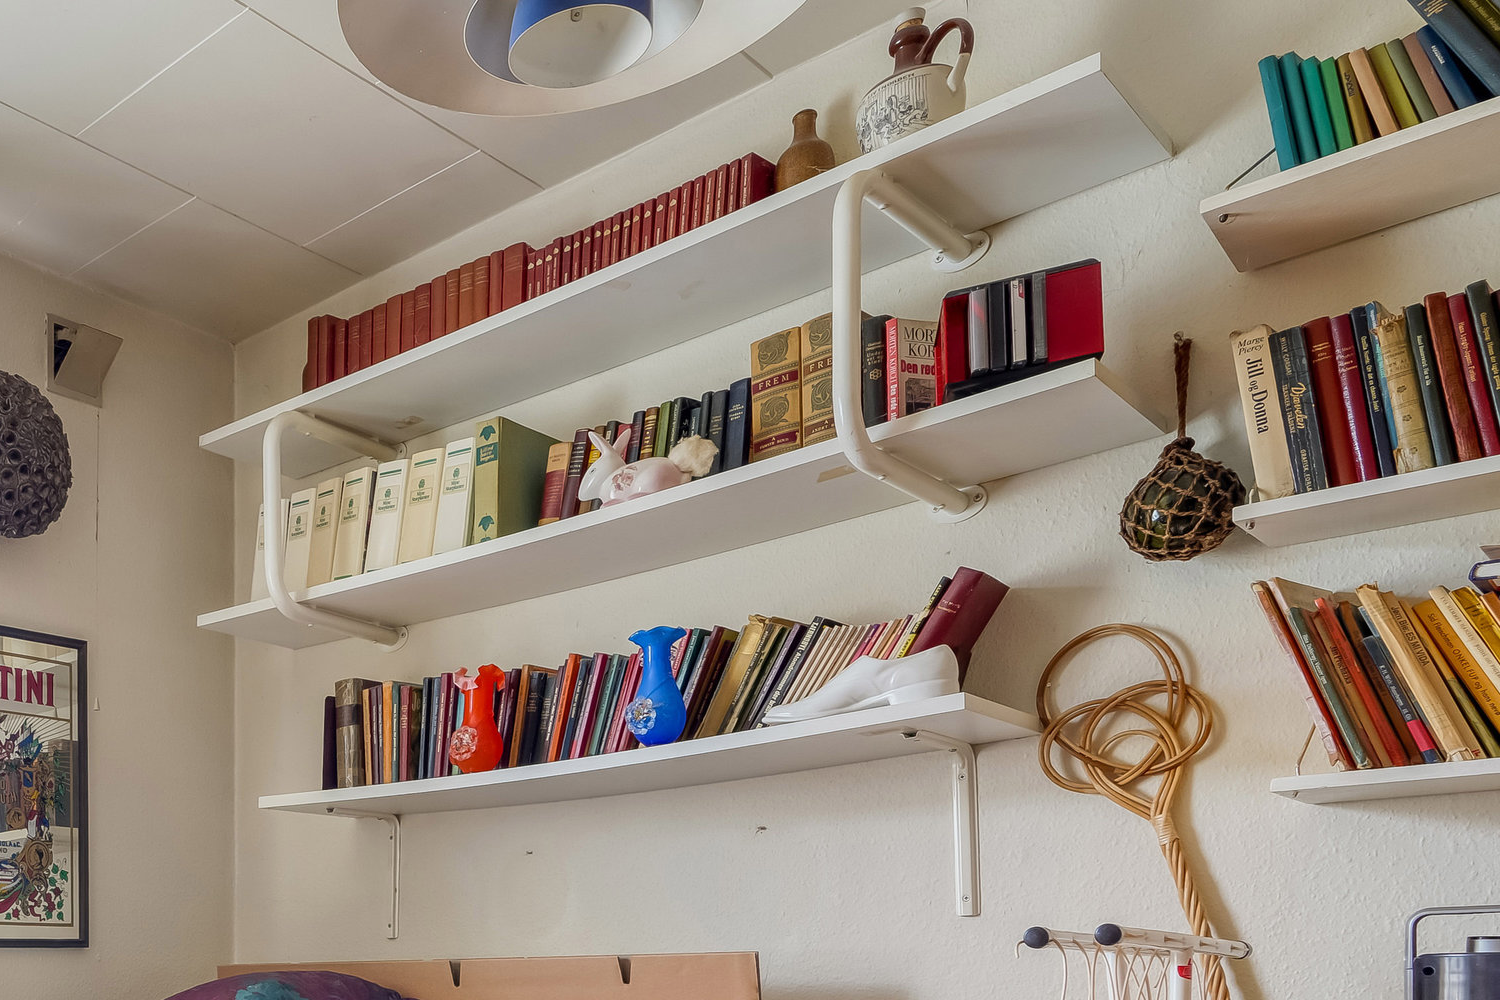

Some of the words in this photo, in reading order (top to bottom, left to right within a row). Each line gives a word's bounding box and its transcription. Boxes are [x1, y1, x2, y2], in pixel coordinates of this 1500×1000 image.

[908, 343, 936, 357] KOR
[1238, 336, 1264, 349] Marge
[1238, 344, 1264, 356] Piercy
[809, 358, 833, 372] FRE
[900, 360, 918, 374] Den
[921, 362, 936, 376] rød
[1246, 358, 1263, 378] Jill
[758, 374, 790, 390] FREM
[1248, 380, 1258, 391] og
[1252, 390, 1268, 433] Donna
[1290, 382, 1307, 428] Djævelen
[1303, 473, 1312, 491] FORLA
[1405, 631, 1416, 641] ES
[1410, 641, 1421, 650] MI
[1416, 649, 1429, 666] VIDA
[1452, 649, 1469, 669] ONKEL
[1474, 681, 1482, 689] og
